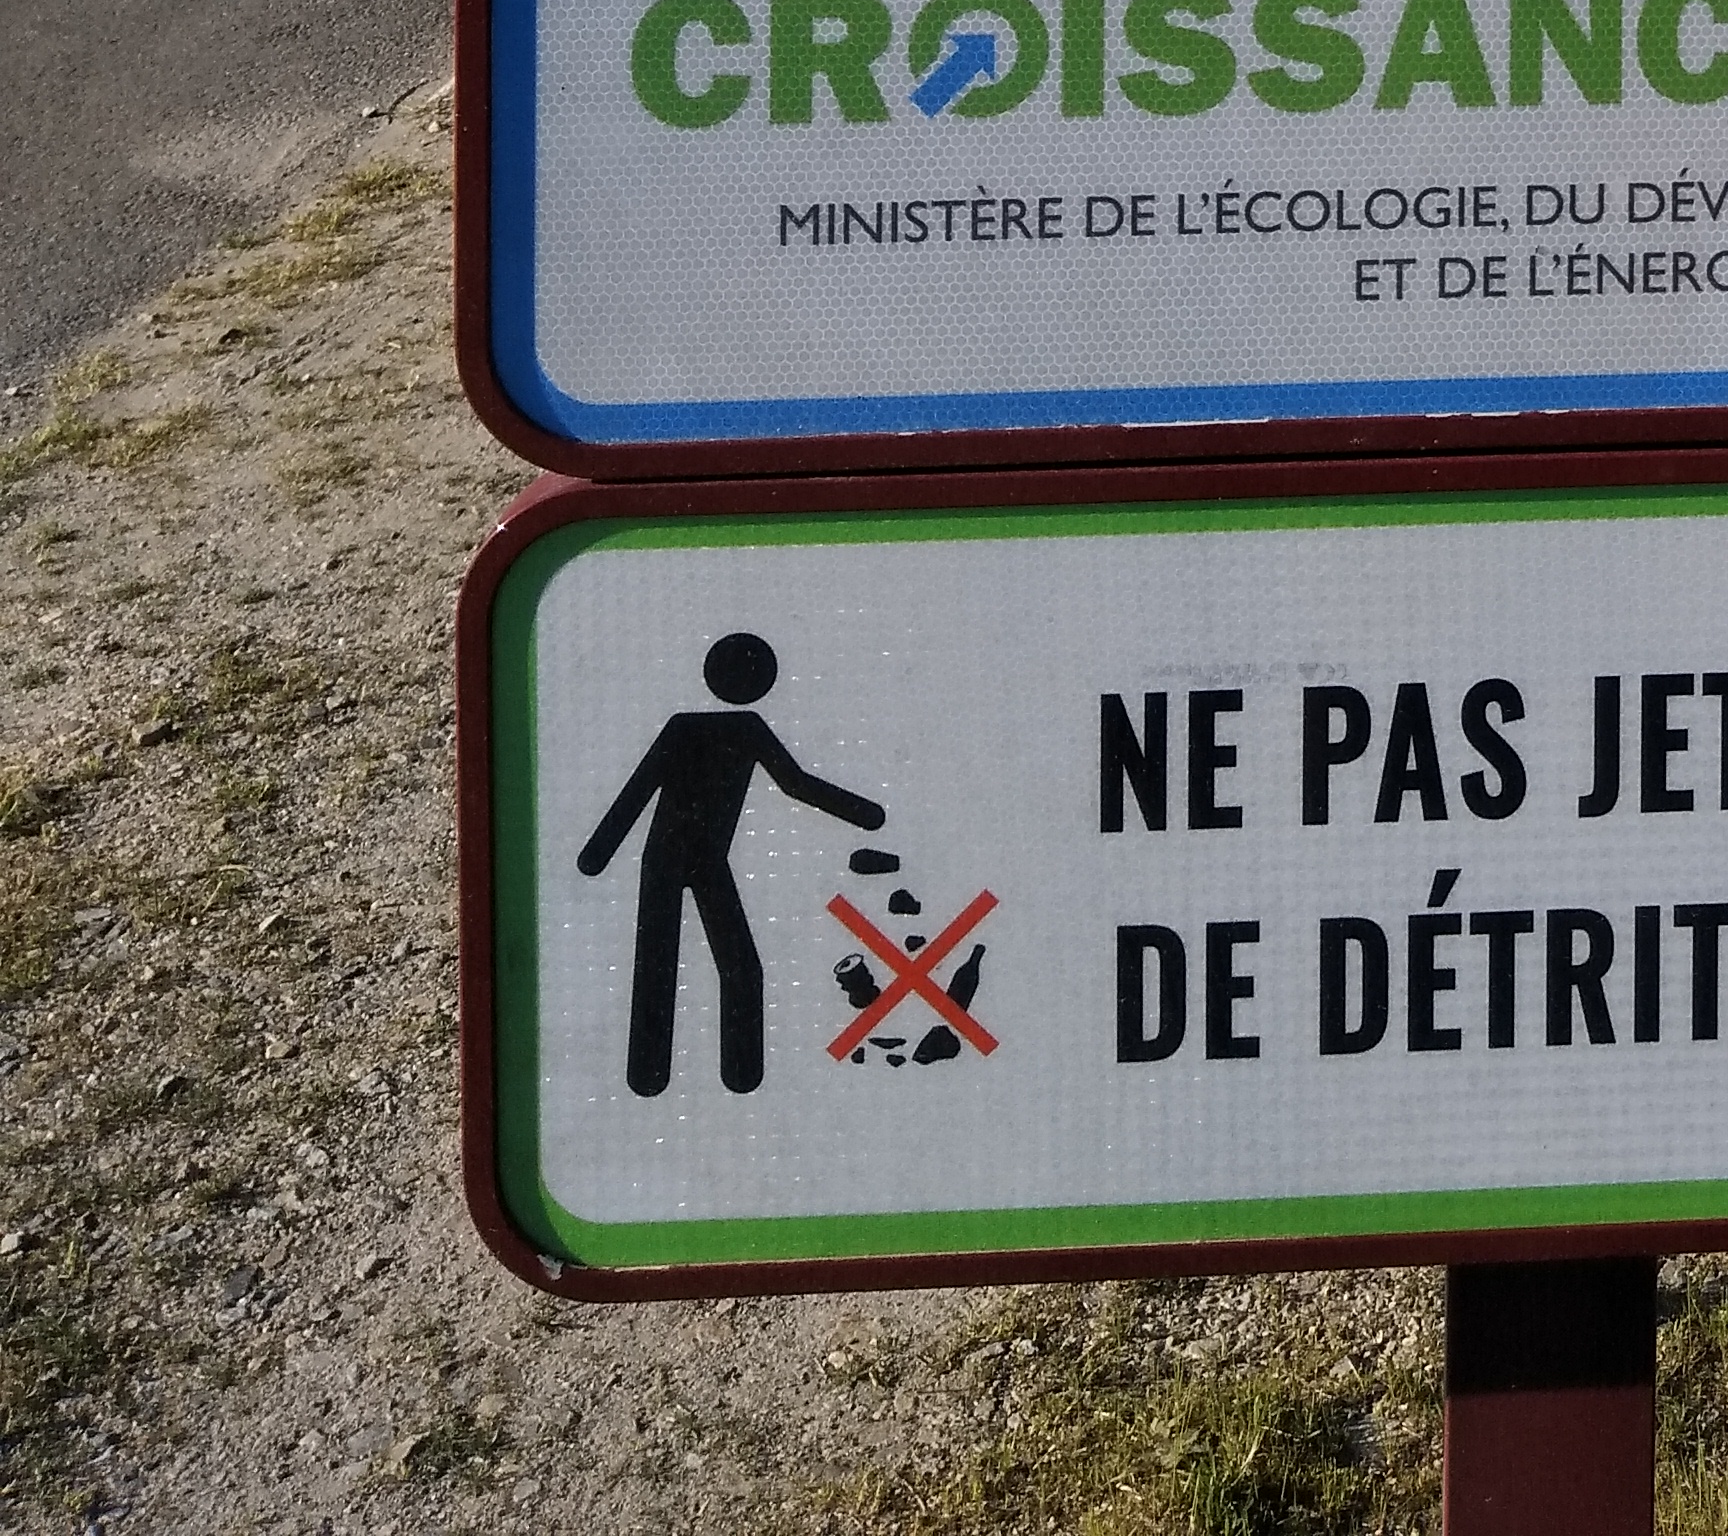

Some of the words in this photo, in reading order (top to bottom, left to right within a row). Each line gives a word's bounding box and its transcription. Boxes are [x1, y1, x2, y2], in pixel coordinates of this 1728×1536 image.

[779, 185, 1063, 246] MINISTÈRE
[1085, 196, 1155, 237] DE
[1527, 184, 1608, 226] DU
[1356, 259, 1416, 301] ET
[1439, 256, 1507, 299] DE
[1099, 690, 1242, 834] NE
[1302, 679, 1527, 825] PAS
[1117, 918, 1261, 1064] DE
